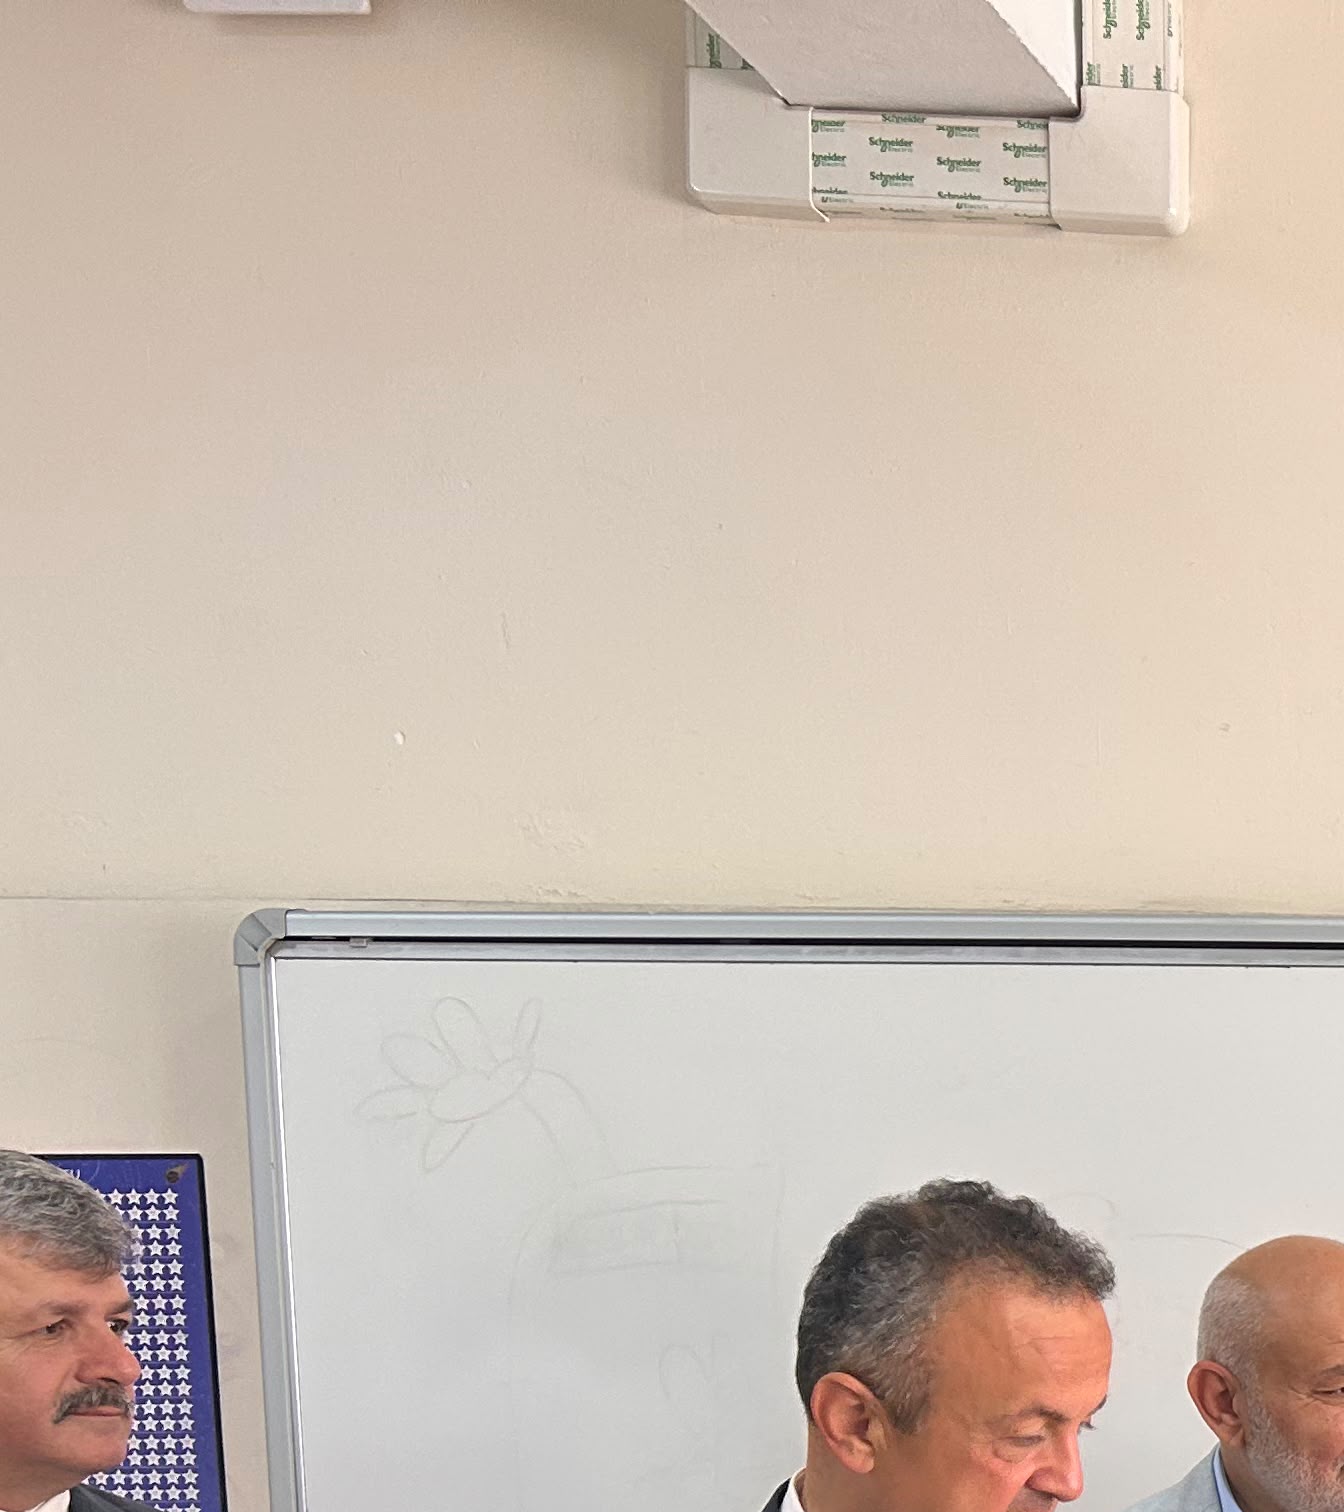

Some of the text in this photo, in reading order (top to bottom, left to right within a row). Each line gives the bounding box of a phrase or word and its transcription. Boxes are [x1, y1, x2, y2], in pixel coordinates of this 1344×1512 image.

[868, 137, 913, 152] Schneider
[1003, 143, 1047, 158] Schneider
[936, 157, 981, 172] Schneider
[870, 171, 914, 187] Schneider
[1003, 177, 1047, 193] Schneider
